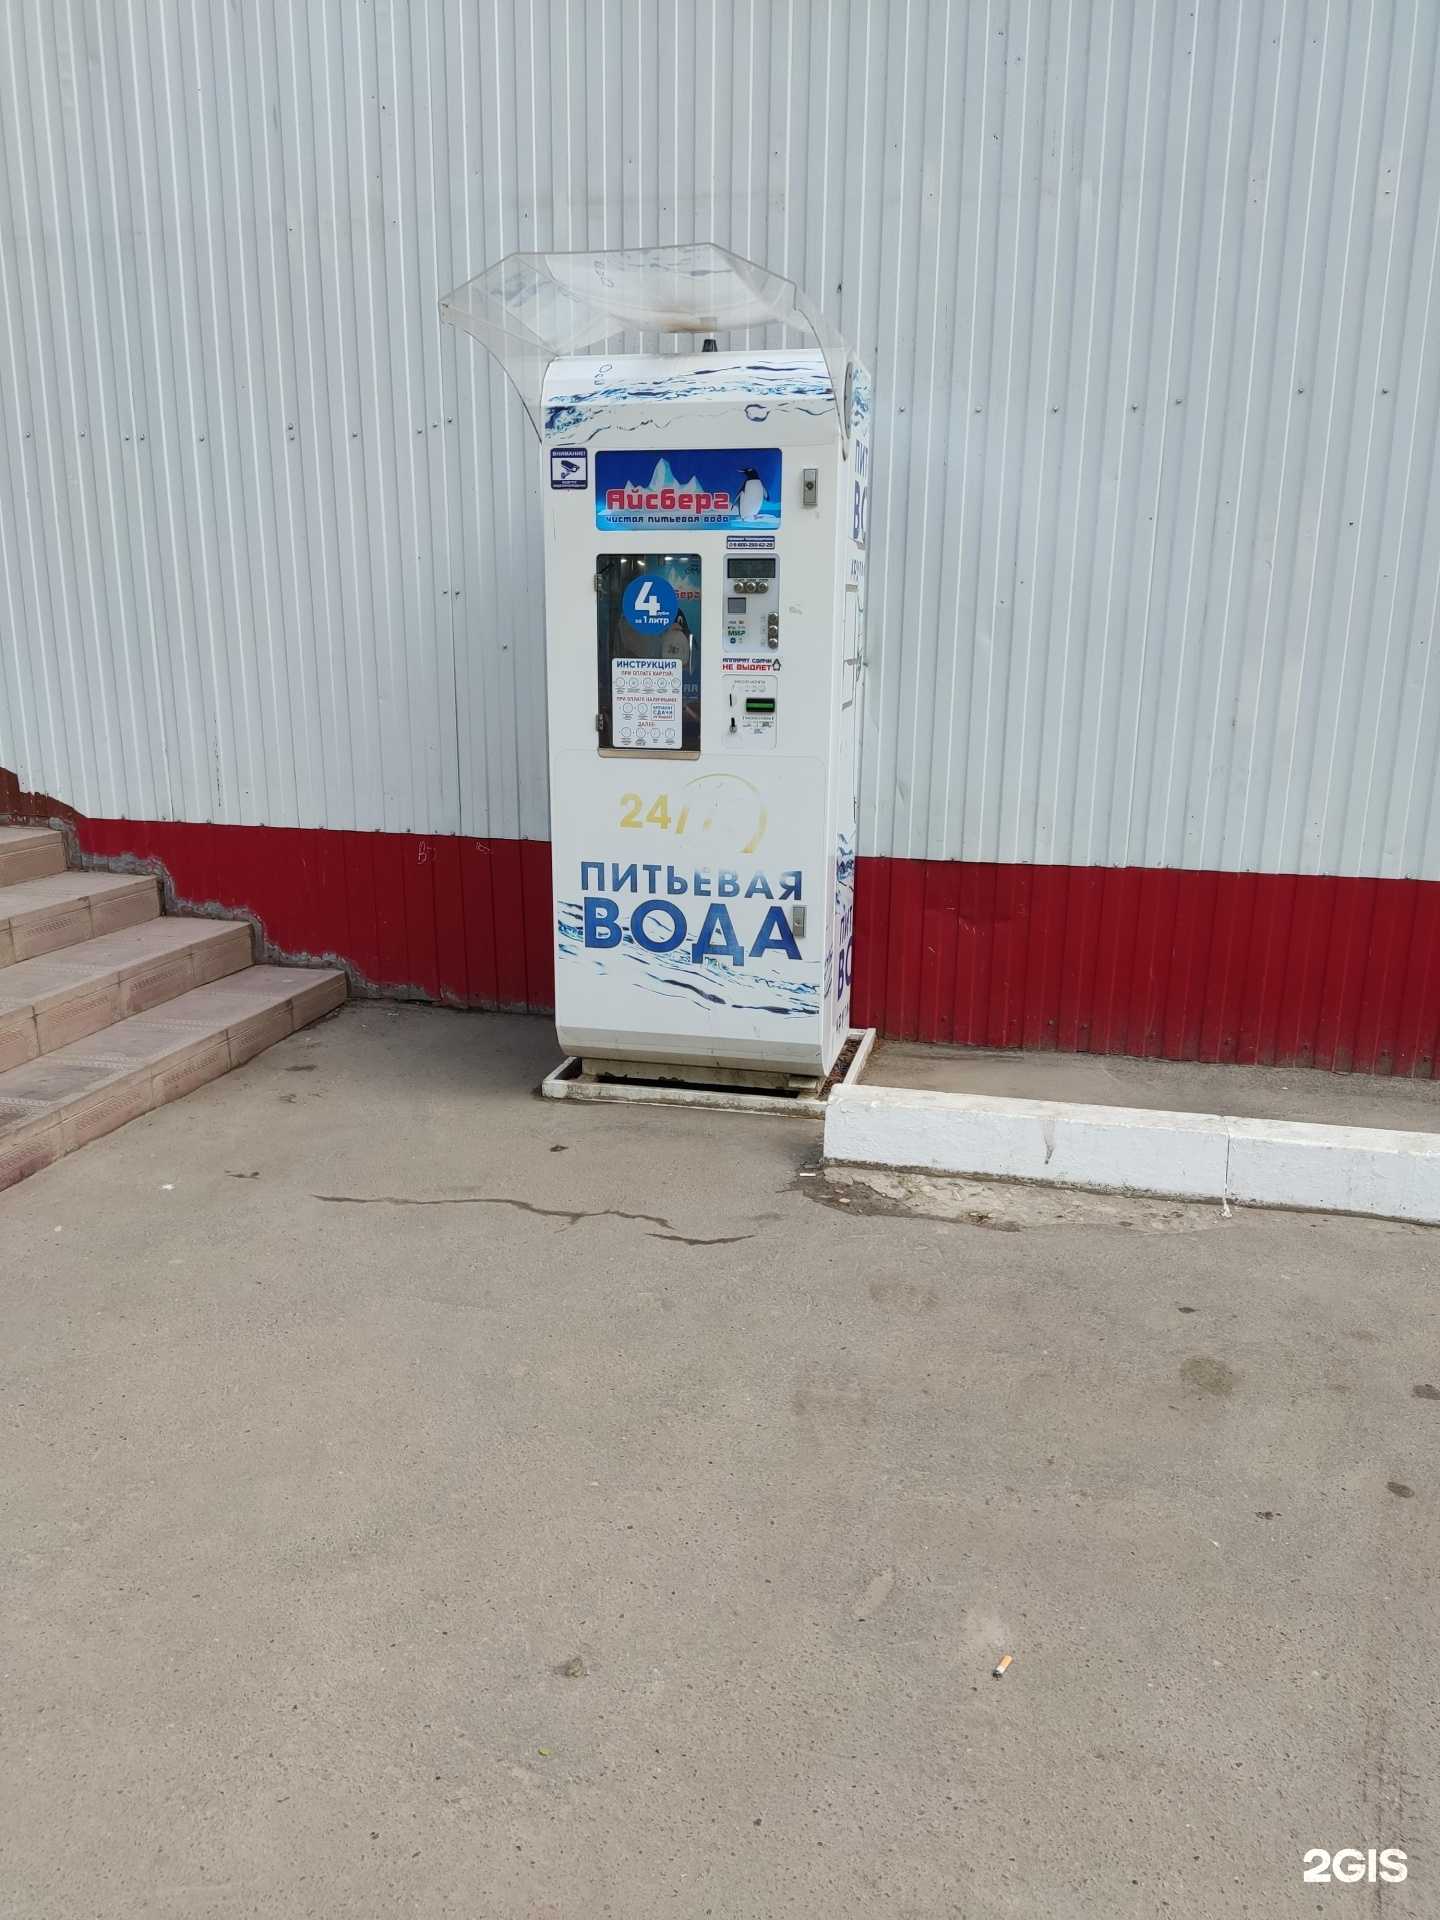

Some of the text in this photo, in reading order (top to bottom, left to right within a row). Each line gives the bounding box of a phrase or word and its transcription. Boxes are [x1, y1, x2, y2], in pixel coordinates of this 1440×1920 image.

[606, 489, 730, 514] Айсберг
[648, 515, 700, 523] питьевая
[634, 581, 661, 616] 4
[643, 616, 649, 624] 1
[649, 617, 670, 625] литр
[616, 660, 677, 670] ИНСТРУКЦИЯ
[581, 861, 802, 900] ПИТЬЕВАЯ
[584, 896, 803, 966] ВОДА
